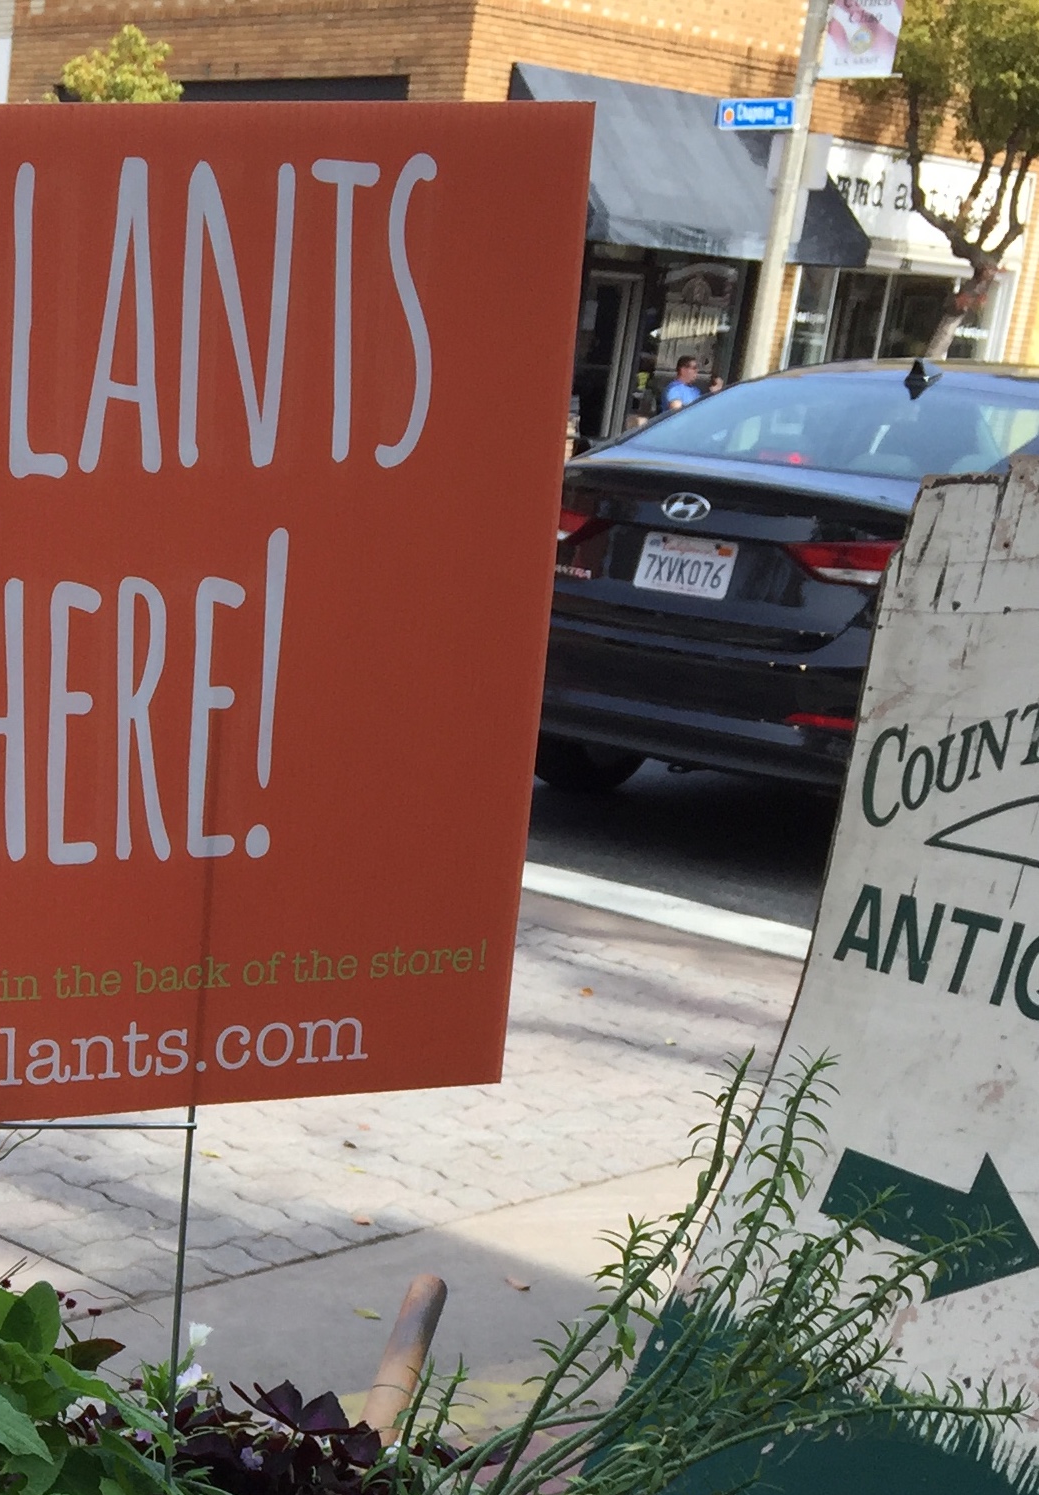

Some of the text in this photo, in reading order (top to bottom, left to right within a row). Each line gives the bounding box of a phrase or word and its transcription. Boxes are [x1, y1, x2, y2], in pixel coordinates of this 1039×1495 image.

[644, 553, 727, 590] 7XVK076
[53, 964, 122, 999] the
[133, 956, 231, 995] back
[242, 951, 292, 986] of
[292, 948, 359, 983] the
[369, 938, 490, 980] store!
